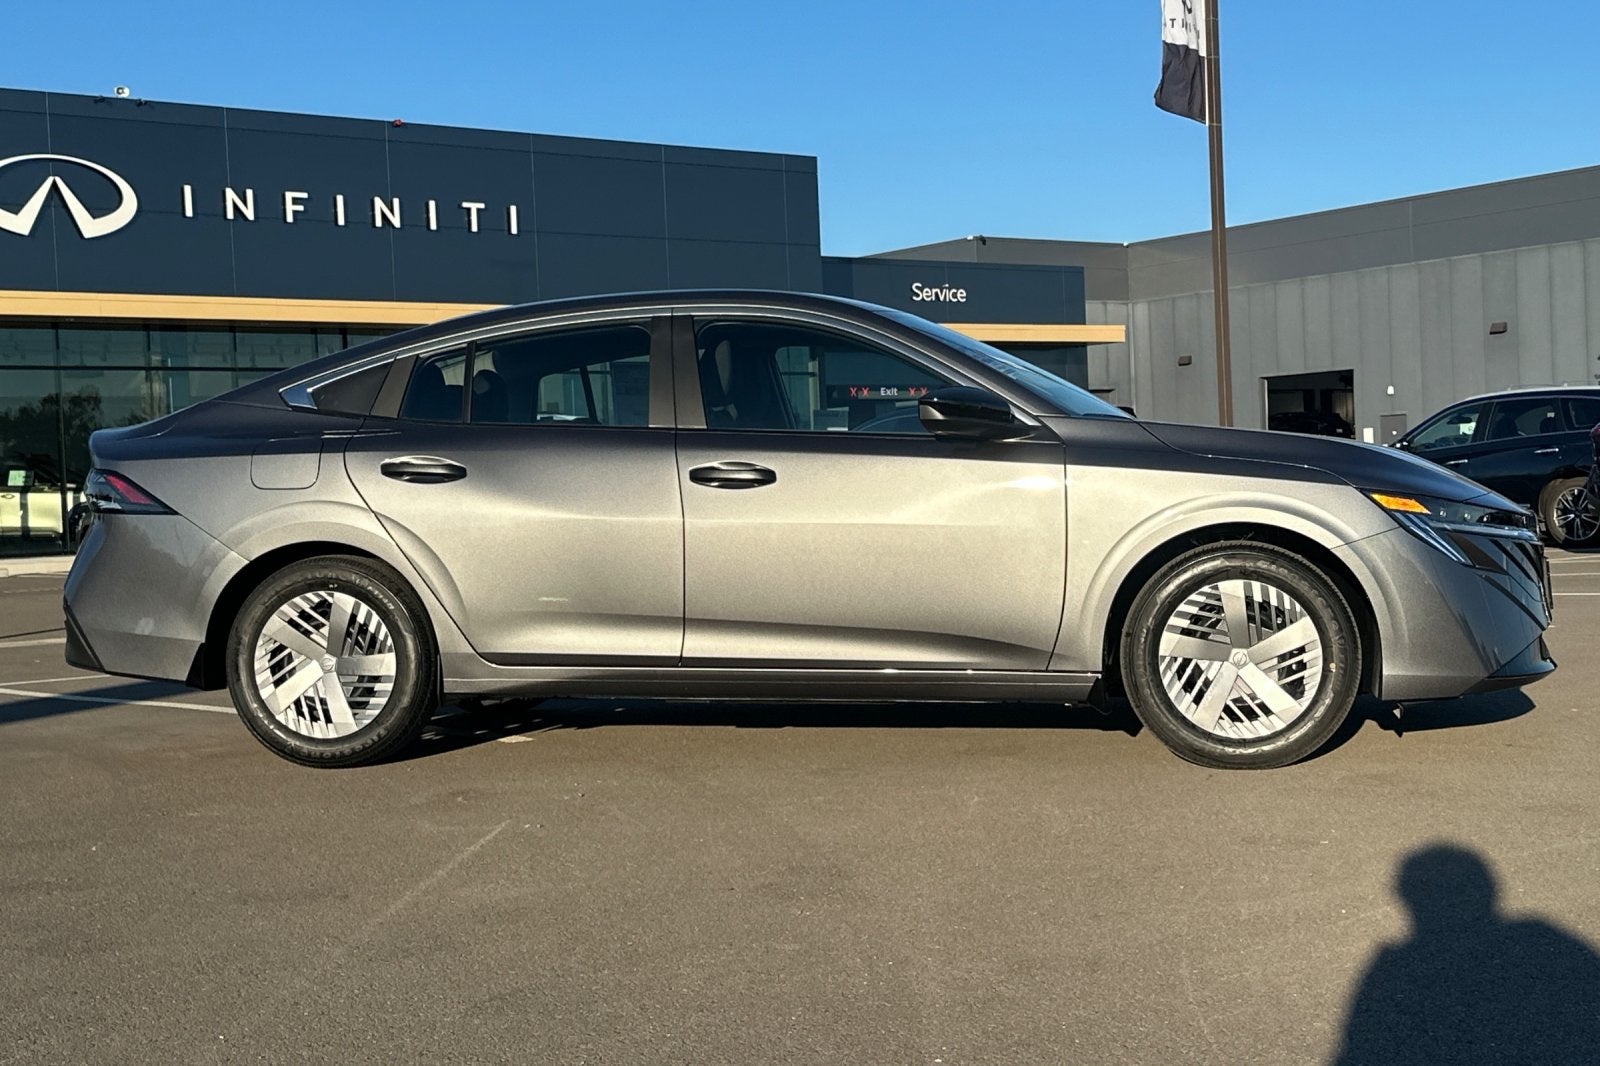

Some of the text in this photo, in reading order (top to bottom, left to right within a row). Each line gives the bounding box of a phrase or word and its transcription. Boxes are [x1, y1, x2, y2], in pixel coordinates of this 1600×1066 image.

[182, 184, 518, 235] INFINITI
[911, 282, 967, 303] Service
[880, 387, 898, 396] Exit
